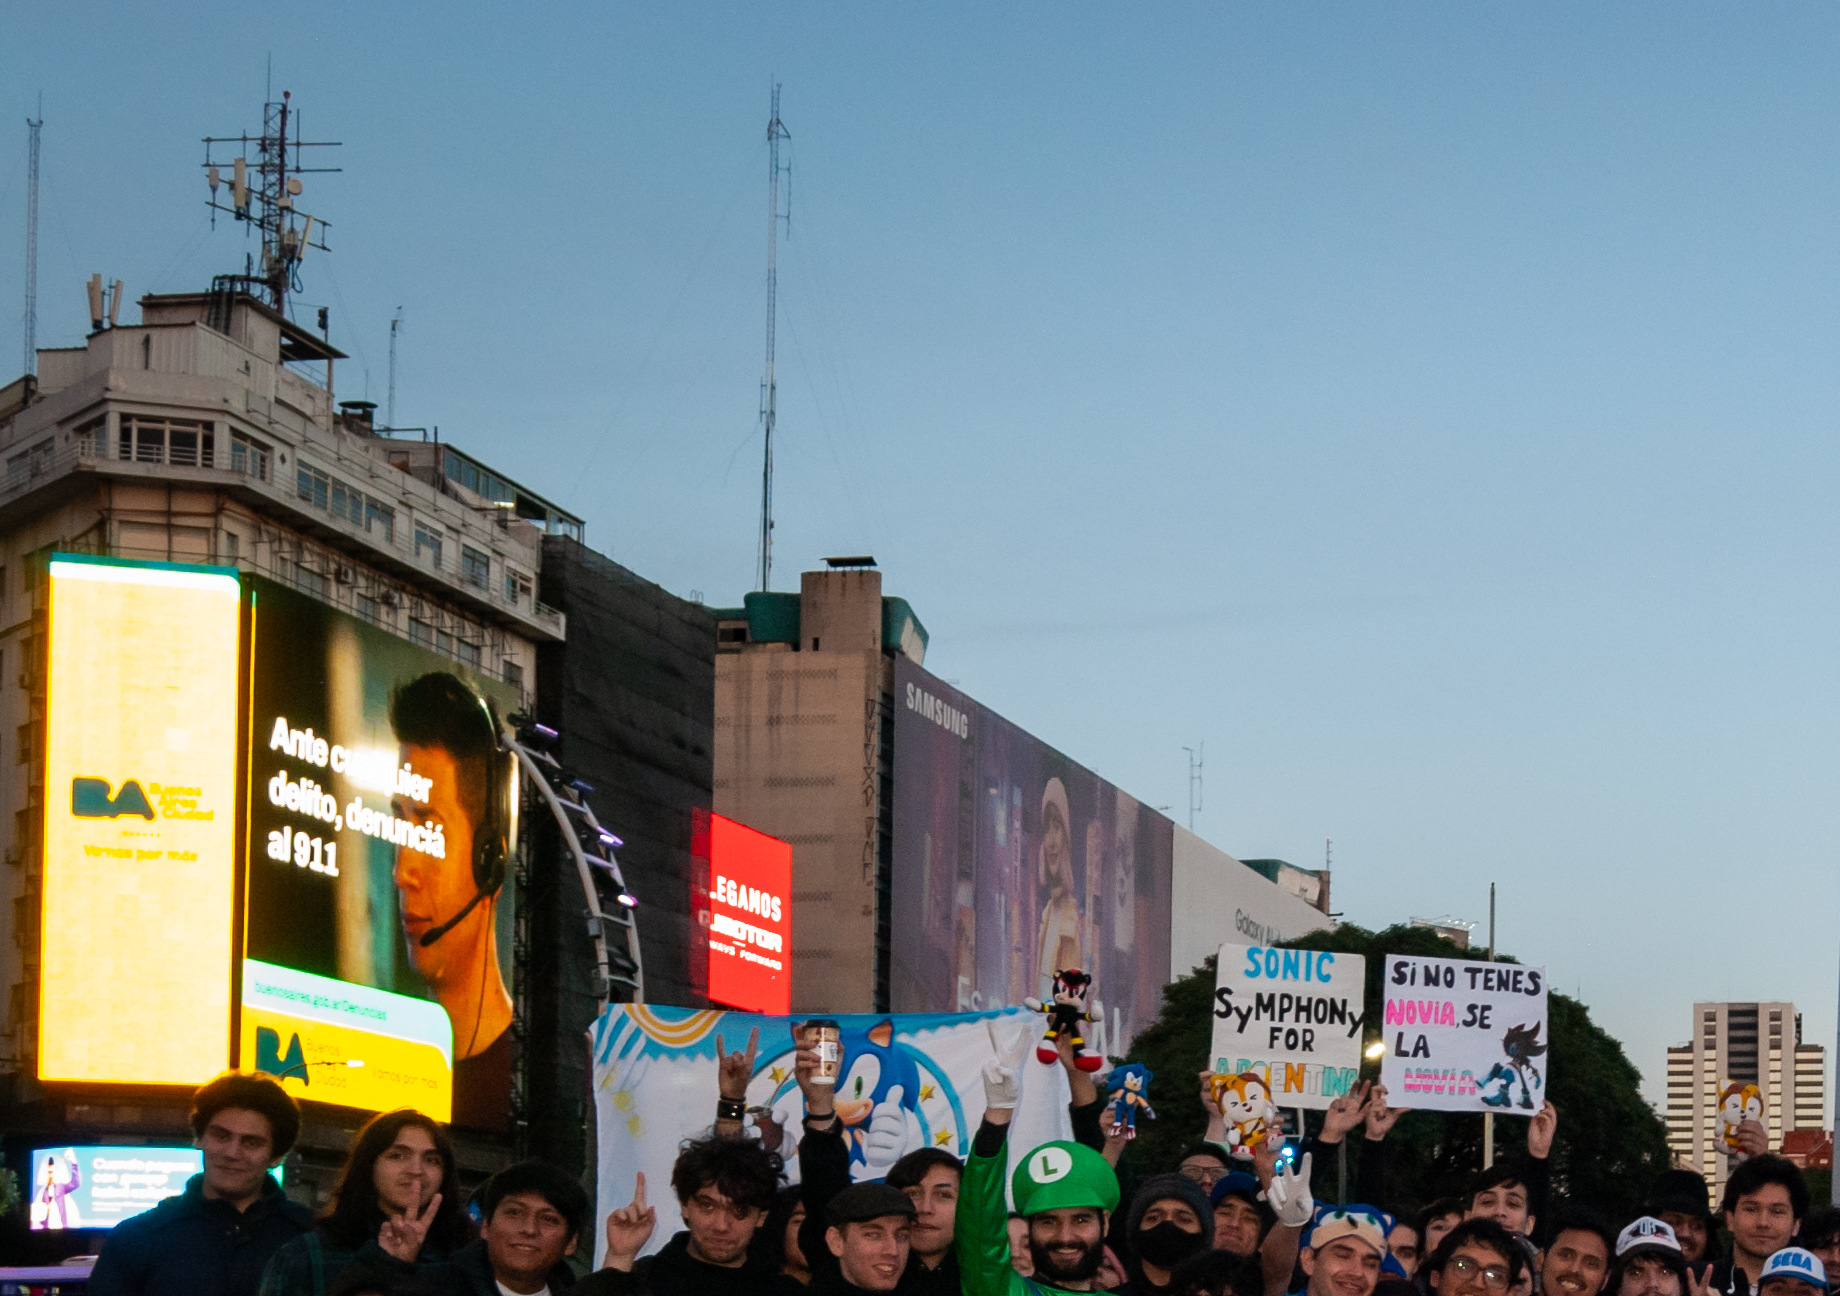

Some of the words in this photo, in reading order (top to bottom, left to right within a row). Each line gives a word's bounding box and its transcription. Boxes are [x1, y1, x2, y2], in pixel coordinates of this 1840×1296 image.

[906, 682, 968, 739] SAMSUNG
[269, 716, 329, 768] Ante
[72, 777, 155, 820] BA
[268, 770, 343, 831] delito,
[345, 796, 446, 860] denunciá
[267, 825, 292, 863] al
[293, 831, 339, 877] 911
[709, 875, 782, 922] EGAMOS
[1244, 946, 1335, 983] SONIC
[1424, 964, 1455, 988] NO
[1464, 966, 1541, 996] TENES
[1462, 1003, 1492, 1029] SE
[255, 1026, 310, 1086] BA
[1268, 1027, 1314, 1052] FOR
[1394, 1031, 1430, 1058] LA
[1042, 1155, 1058, 1177] L
[1771, 1252, 1812, 1272] SEGA
